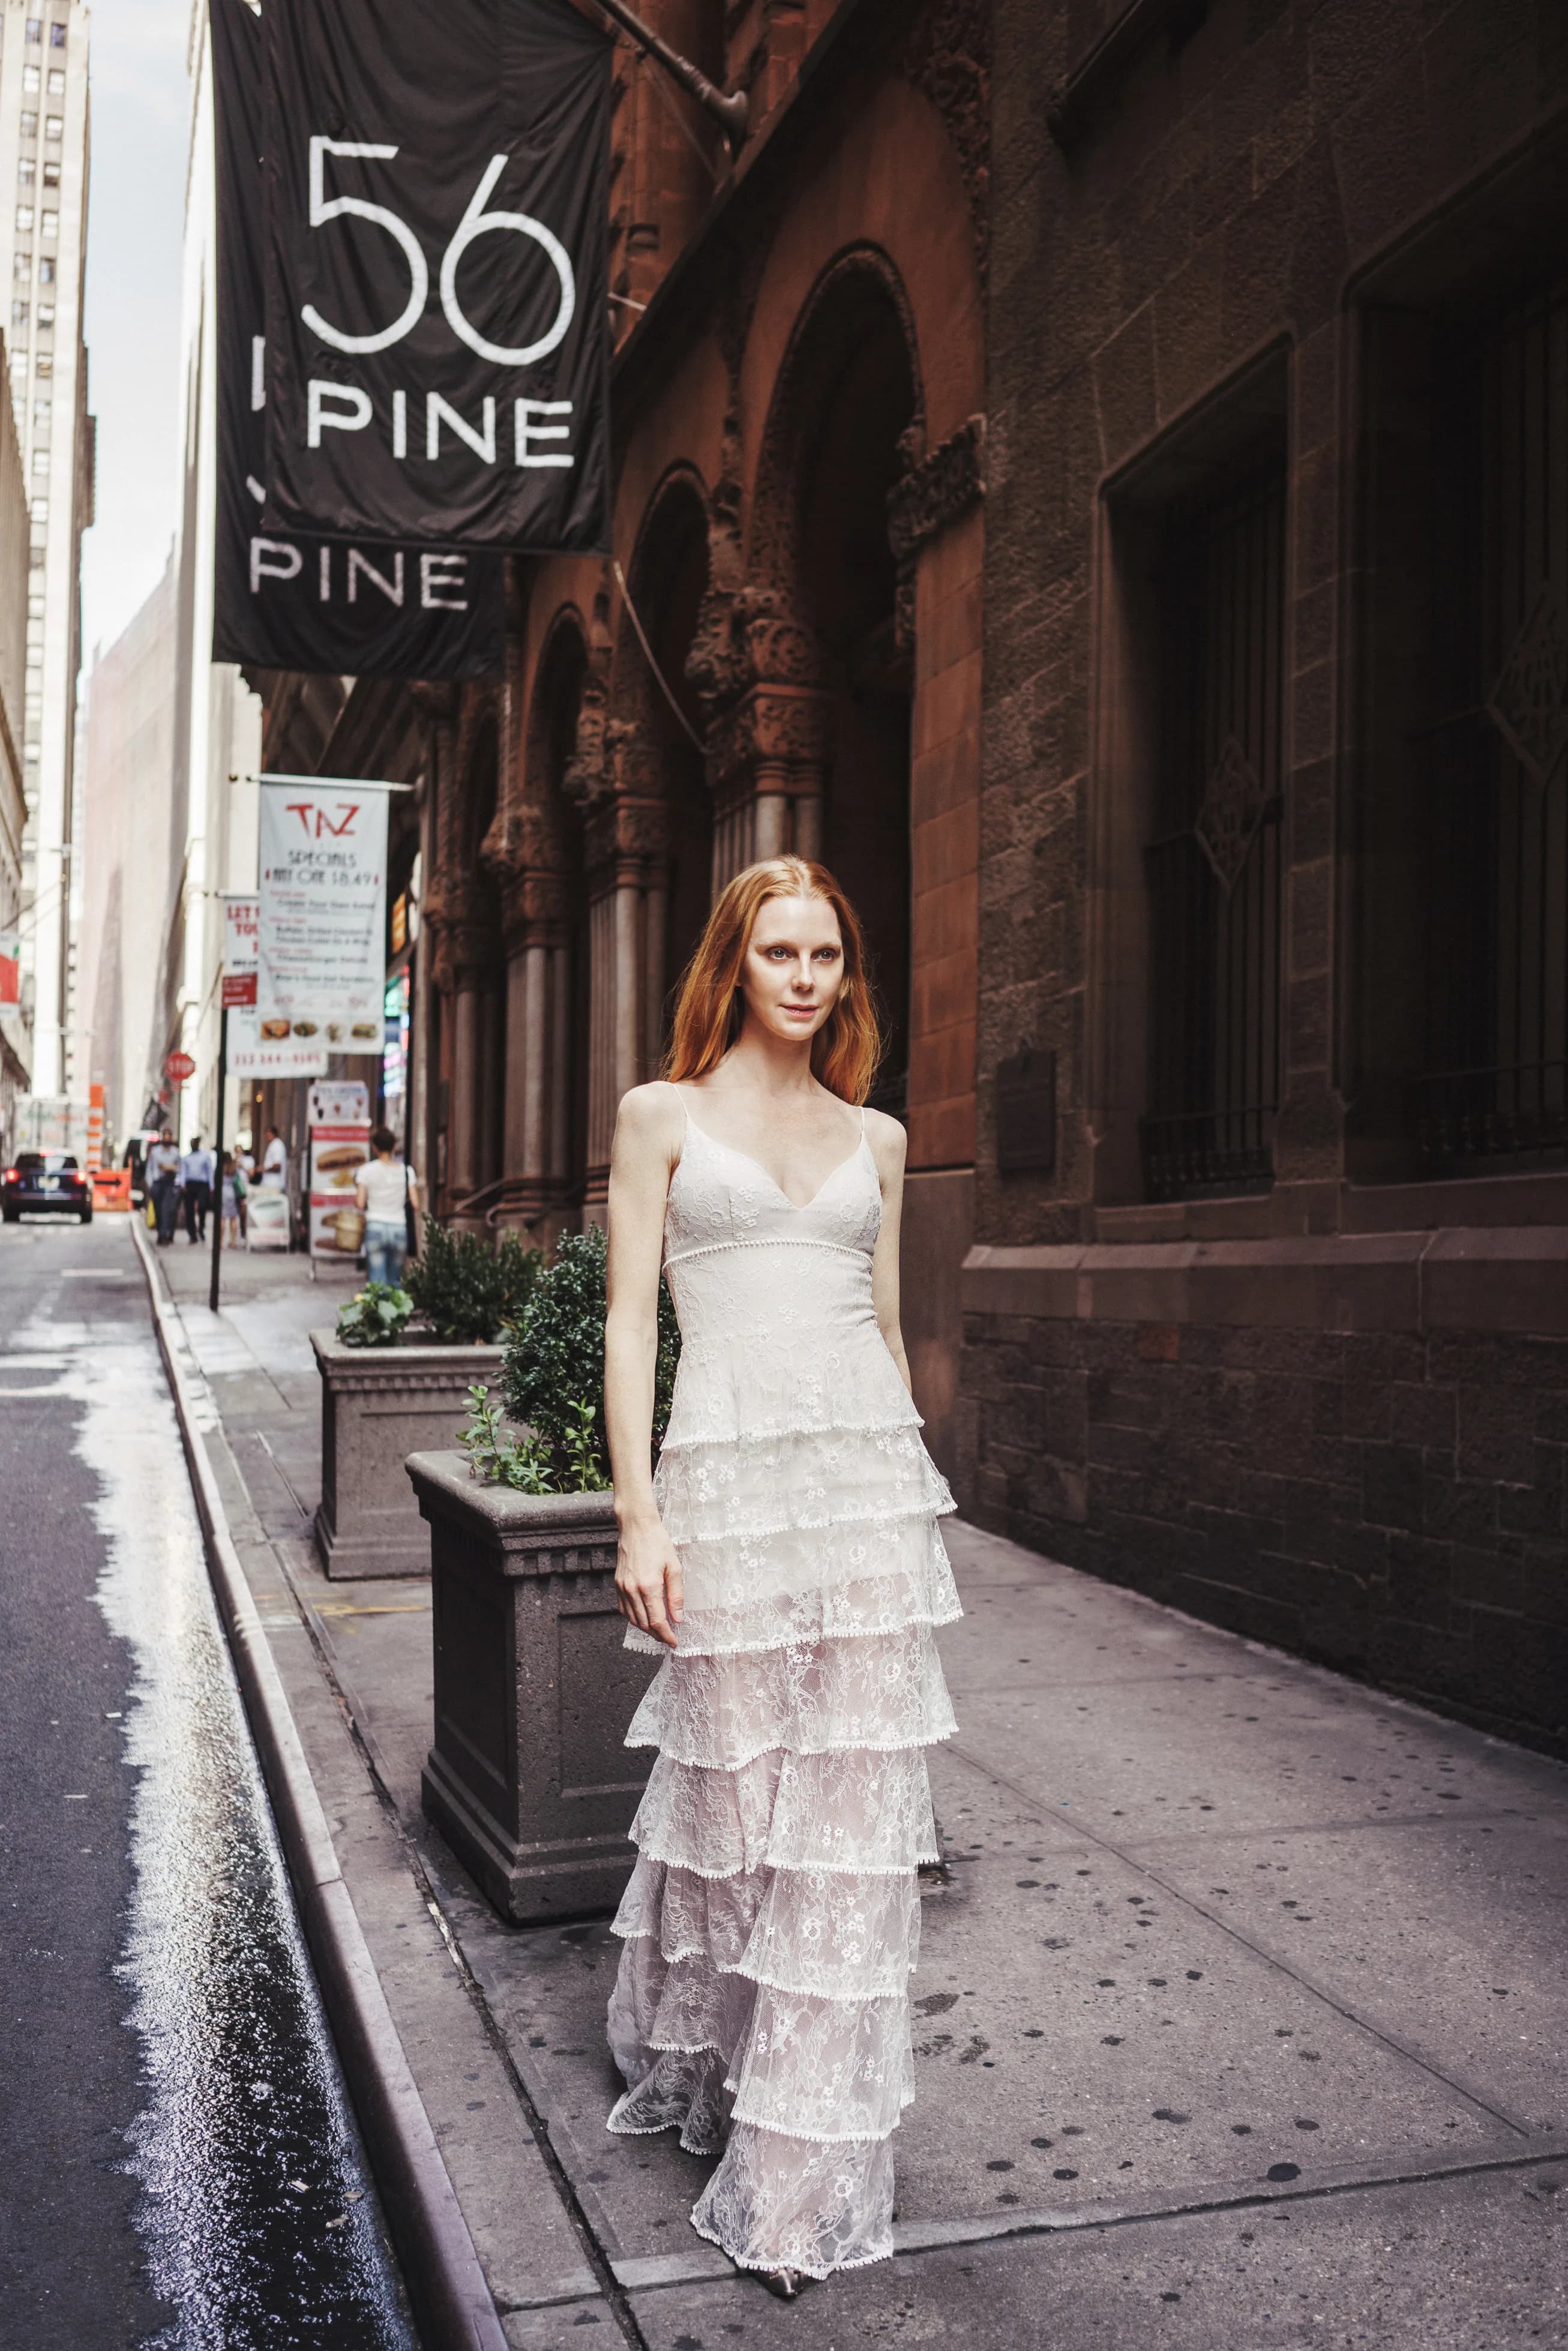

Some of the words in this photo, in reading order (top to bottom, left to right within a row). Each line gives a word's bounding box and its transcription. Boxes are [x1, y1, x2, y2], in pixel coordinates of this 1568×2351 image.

[301, 134, 576, 365] 56
[308, 379, 574, 467] PINE
[250, 537, 468, 610] PINE
[285, 802, 361, 839] TAZ
[289, 849, 357, 868] SPECIALS
[167, 1060, 194, 1073] STOP
